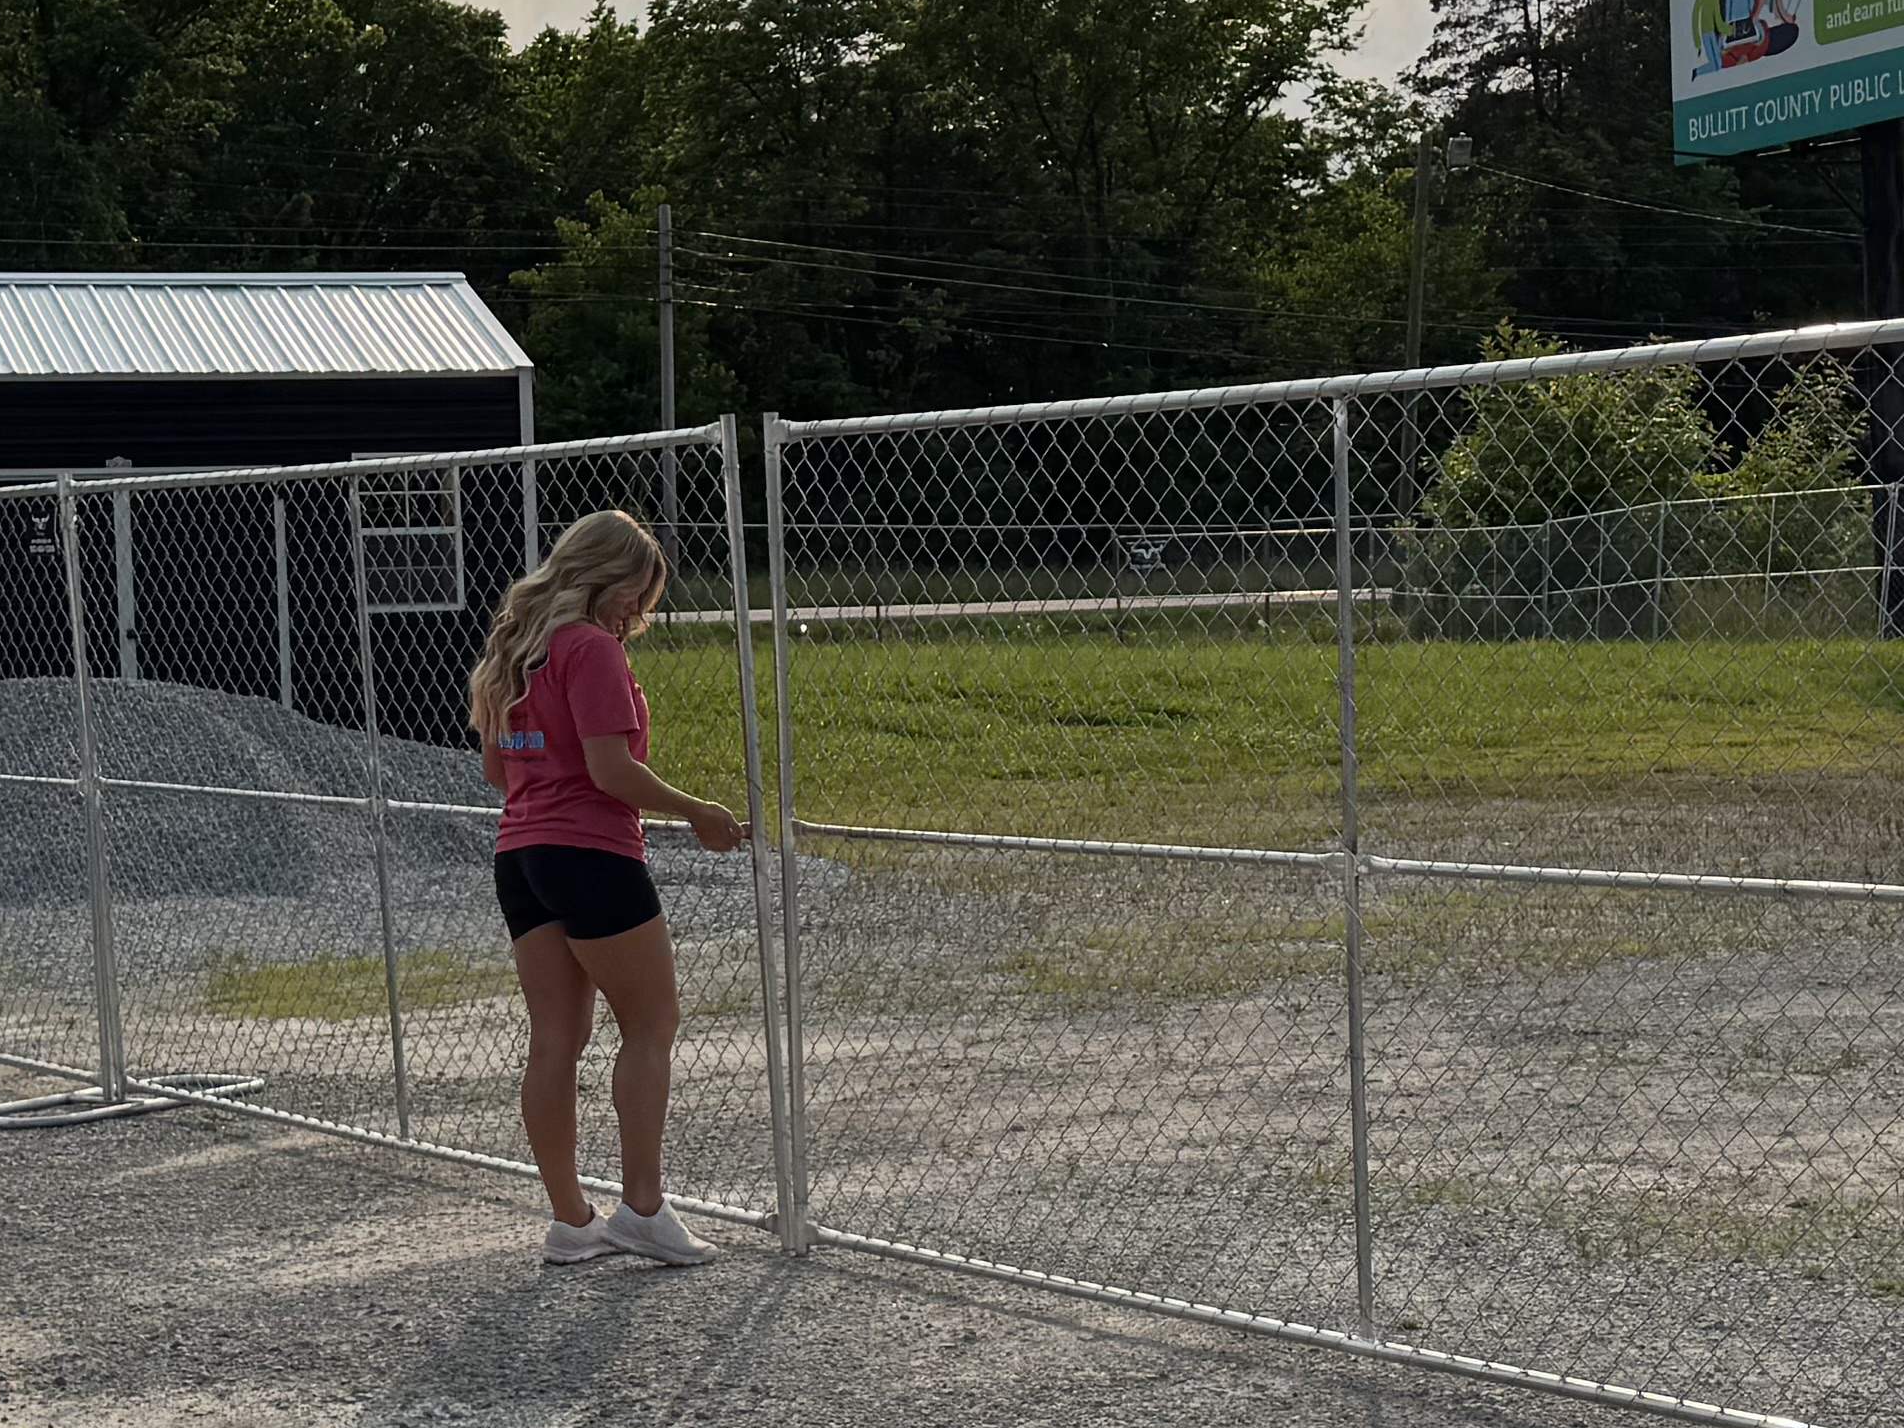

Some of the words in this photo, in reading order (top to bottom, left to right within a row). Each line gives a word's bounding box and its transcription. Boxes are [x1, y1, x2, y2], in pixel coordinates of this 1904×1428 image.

[1826, 4, 1851, 29] and
[1688, 106, 1749, 142] BULLITT
[1754, 88, 1824, 127] COUNTY
[1830, 72, 1892, 109] PUBLIC
